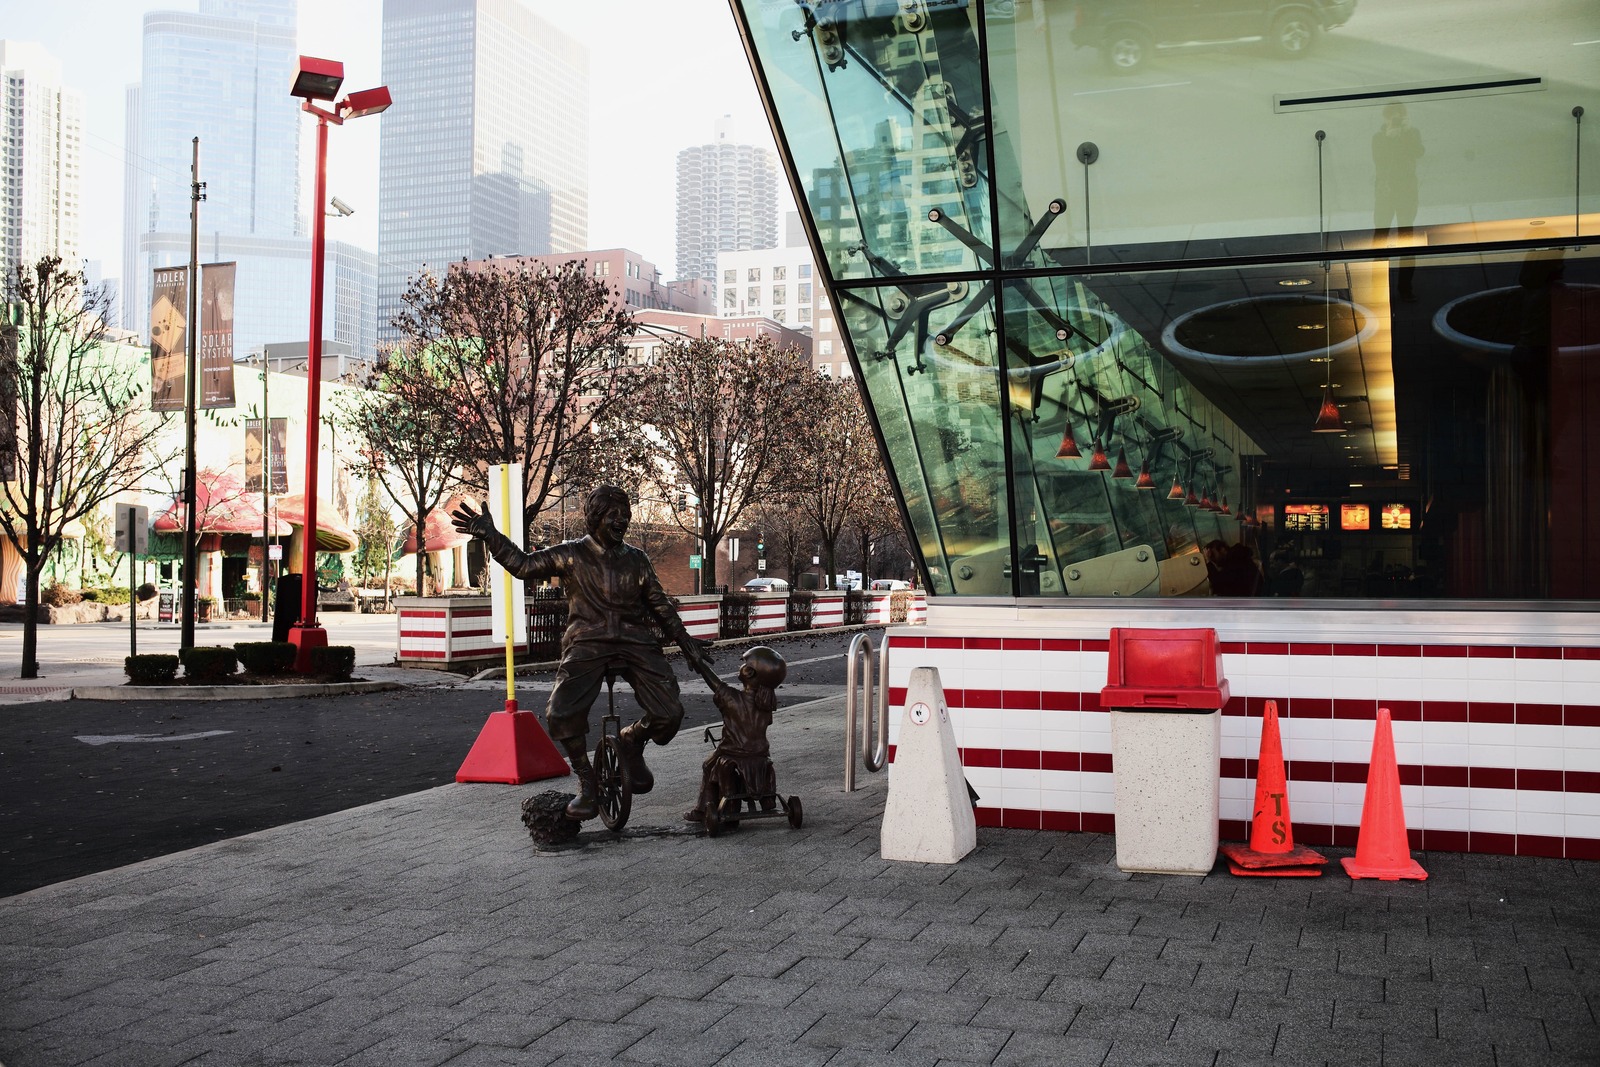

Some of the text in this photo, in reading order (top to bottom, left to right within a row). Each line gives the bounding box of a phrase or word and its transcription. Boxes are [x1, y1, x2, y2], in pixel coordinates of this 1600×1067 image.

[156, 271, 185, 284] ADLER
[202, 333, 232, 348] SOLAR
[202, 347, 232, 359] SYSTEM
